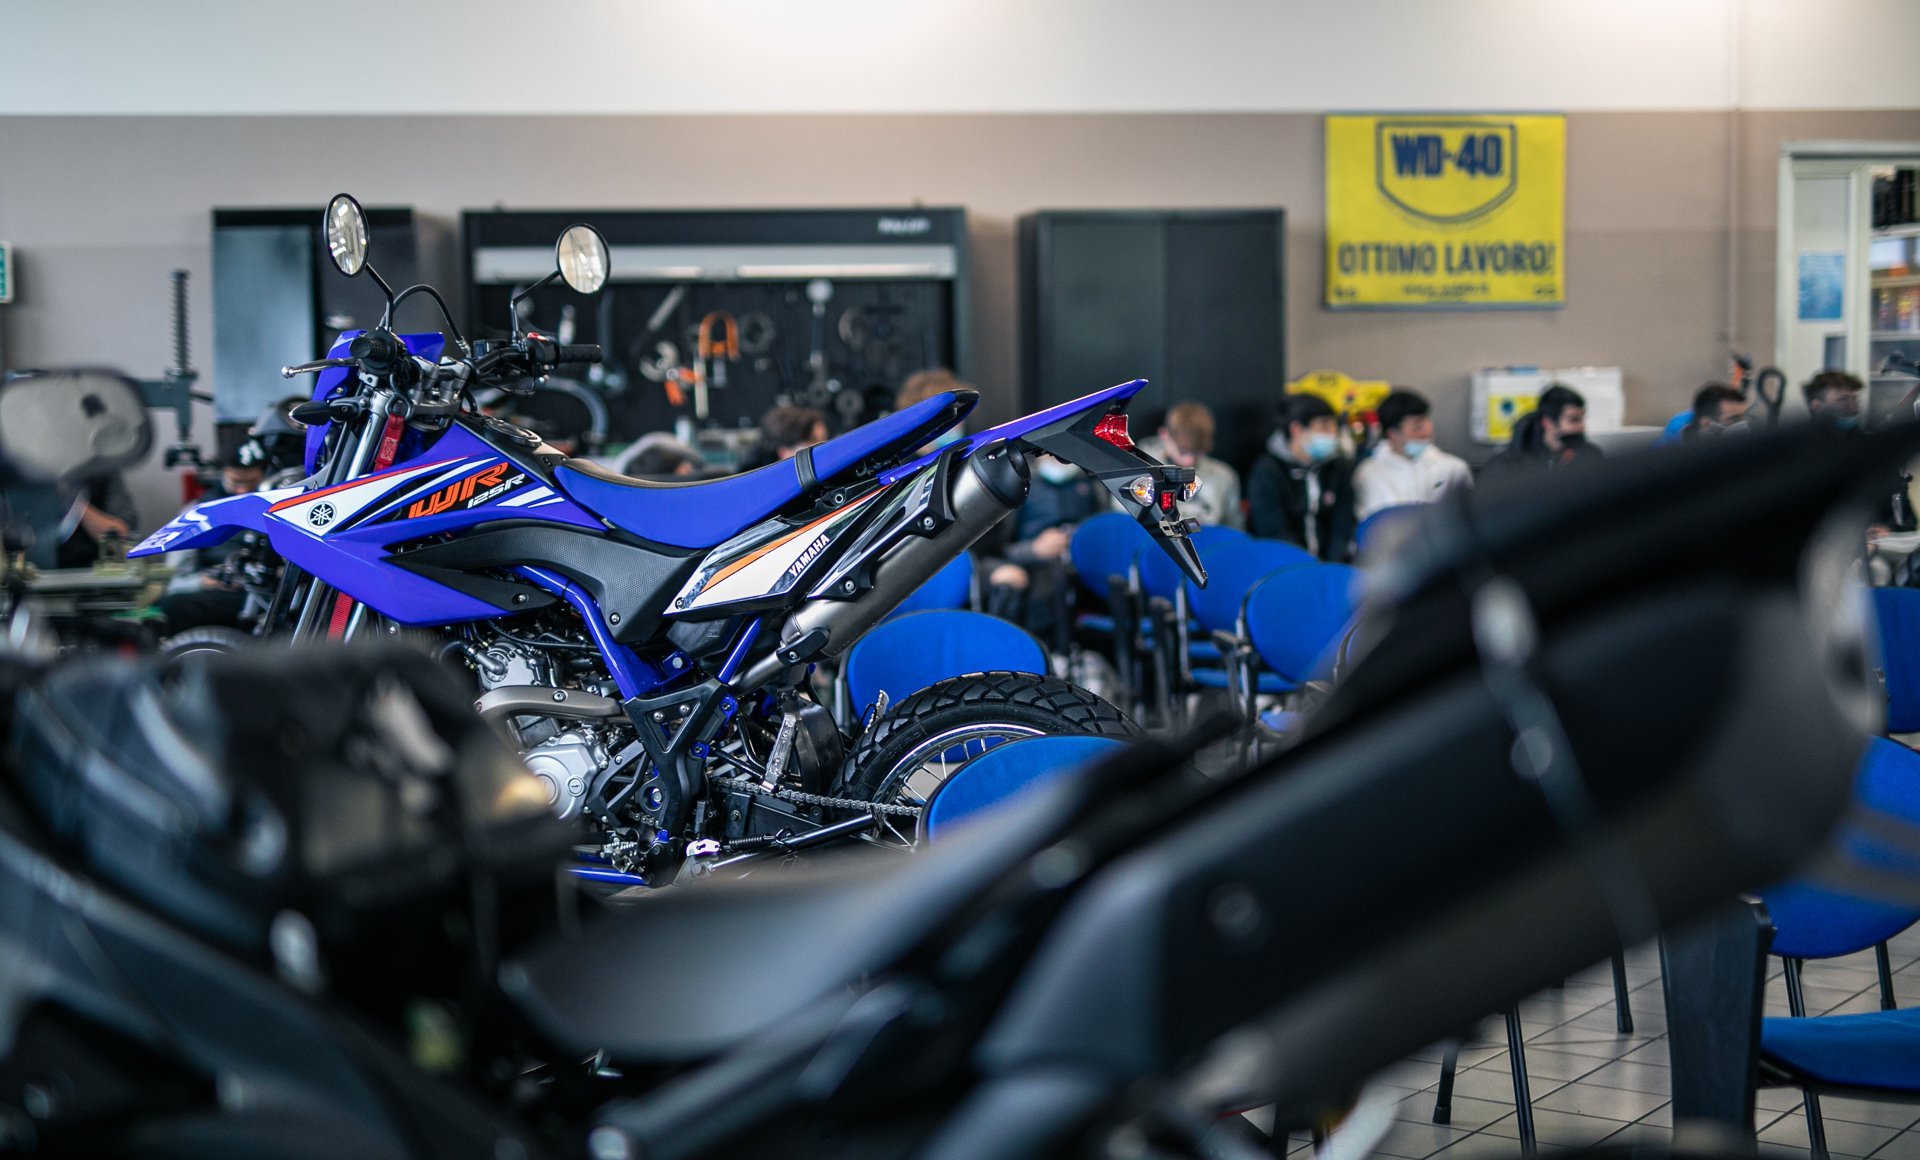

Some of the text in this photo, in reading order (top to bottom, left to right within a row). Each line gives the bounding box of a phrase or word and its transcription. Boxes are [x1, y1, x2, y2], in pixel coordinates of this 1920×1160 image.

[1391, 133, 1504, 178] WD-40
[1338, 241, 1555, 276] OTTIMO LAVORO!
[408, 461, 509, 520] WR
[467, 473, 526, 509] 125R
[788, 533, 830, 577] YAMAHA
